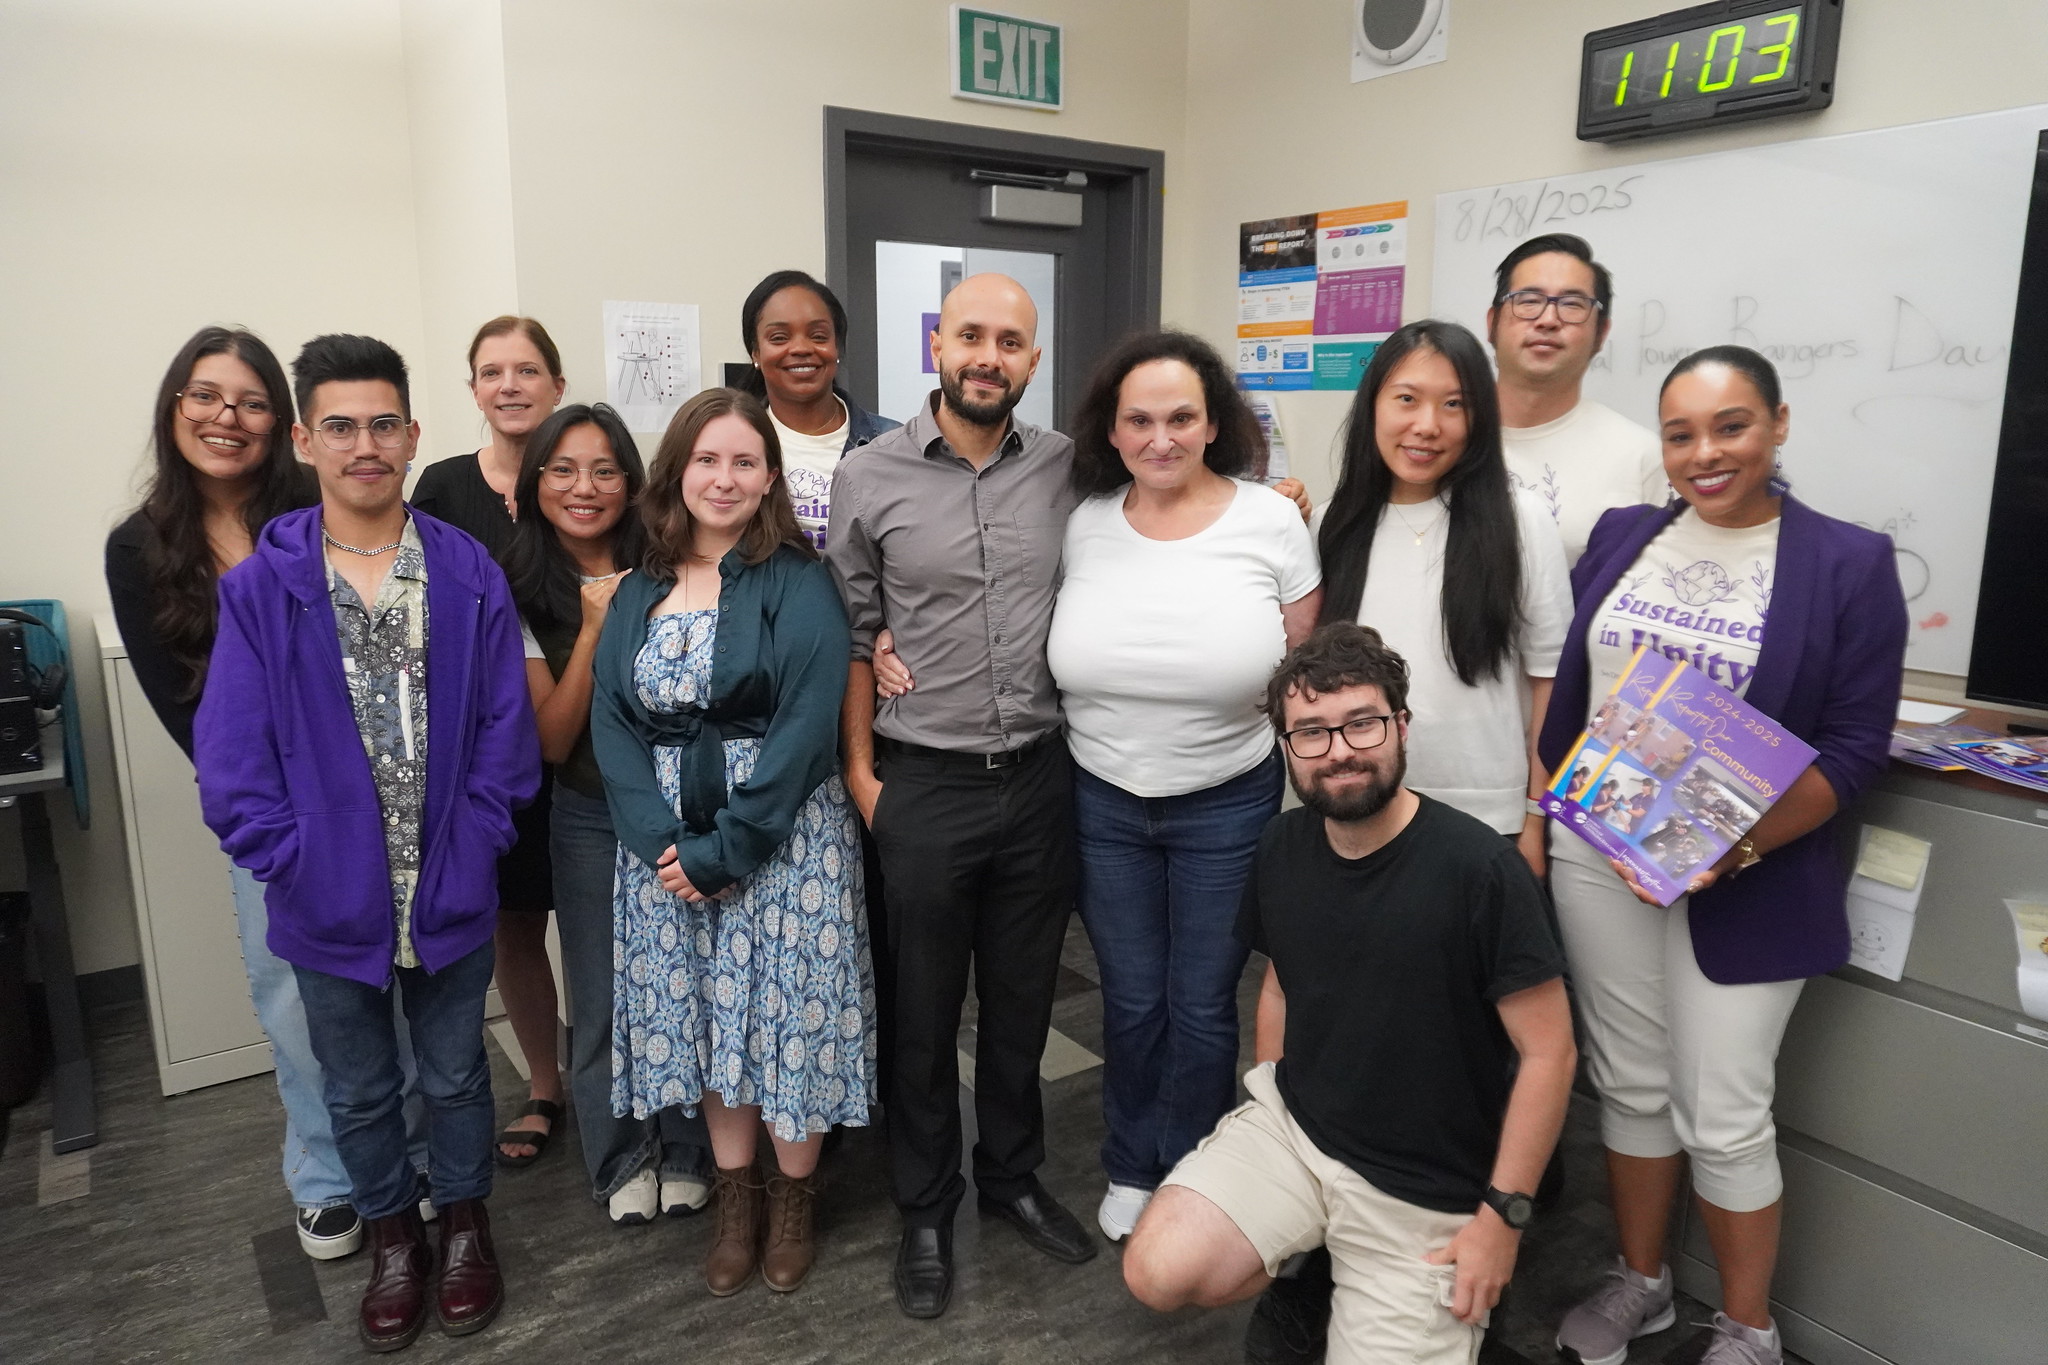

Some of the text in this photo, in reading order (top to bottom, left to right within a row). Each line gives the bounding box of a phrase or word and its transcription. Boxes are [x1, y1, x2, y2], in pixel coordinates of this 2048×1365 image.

[973, 17, 1051, 99] EXIT
[1251, 228, 1307, 242] BREAKING DOWN
[1455, 174, 1645, 242] 8/28/2025
[1251, 245, 1264, 253] THE
[1278, 240, 1304, 249] REPORT
[1599, 623, 1621, 648] in
[1705, 691, 1782, 747] 2024-2025
[1702, 738, 1778, 798] Community
